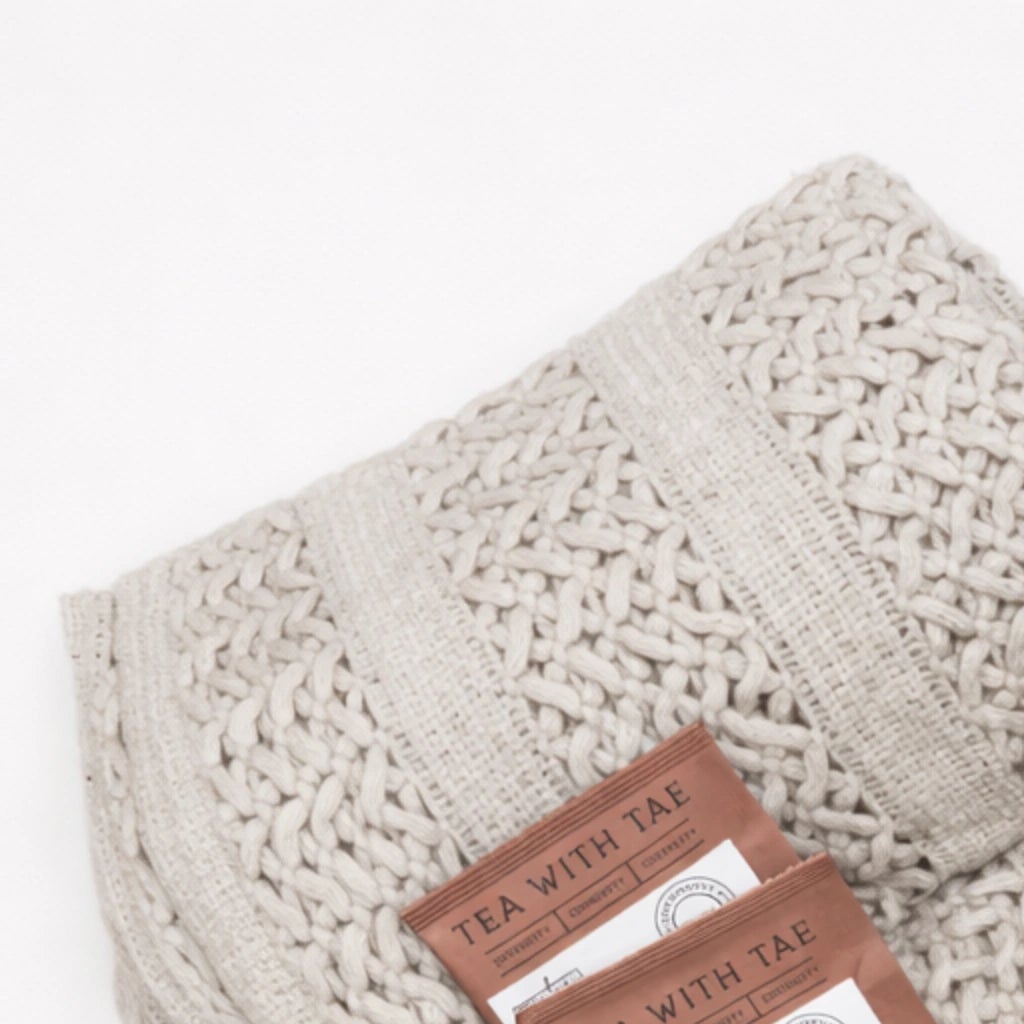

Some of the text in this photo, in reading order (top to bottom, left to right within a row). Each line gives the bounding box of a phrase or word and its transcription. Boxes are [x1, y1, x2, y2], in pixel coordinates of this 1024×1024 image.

[451, 895, 526, 946] TEA
[526, 828, 620, 897] WITH
[621, 779, 691, 834] TAE
[645, 961, 742, 1024] WITH
[747, 919, 817, 969] TAE
